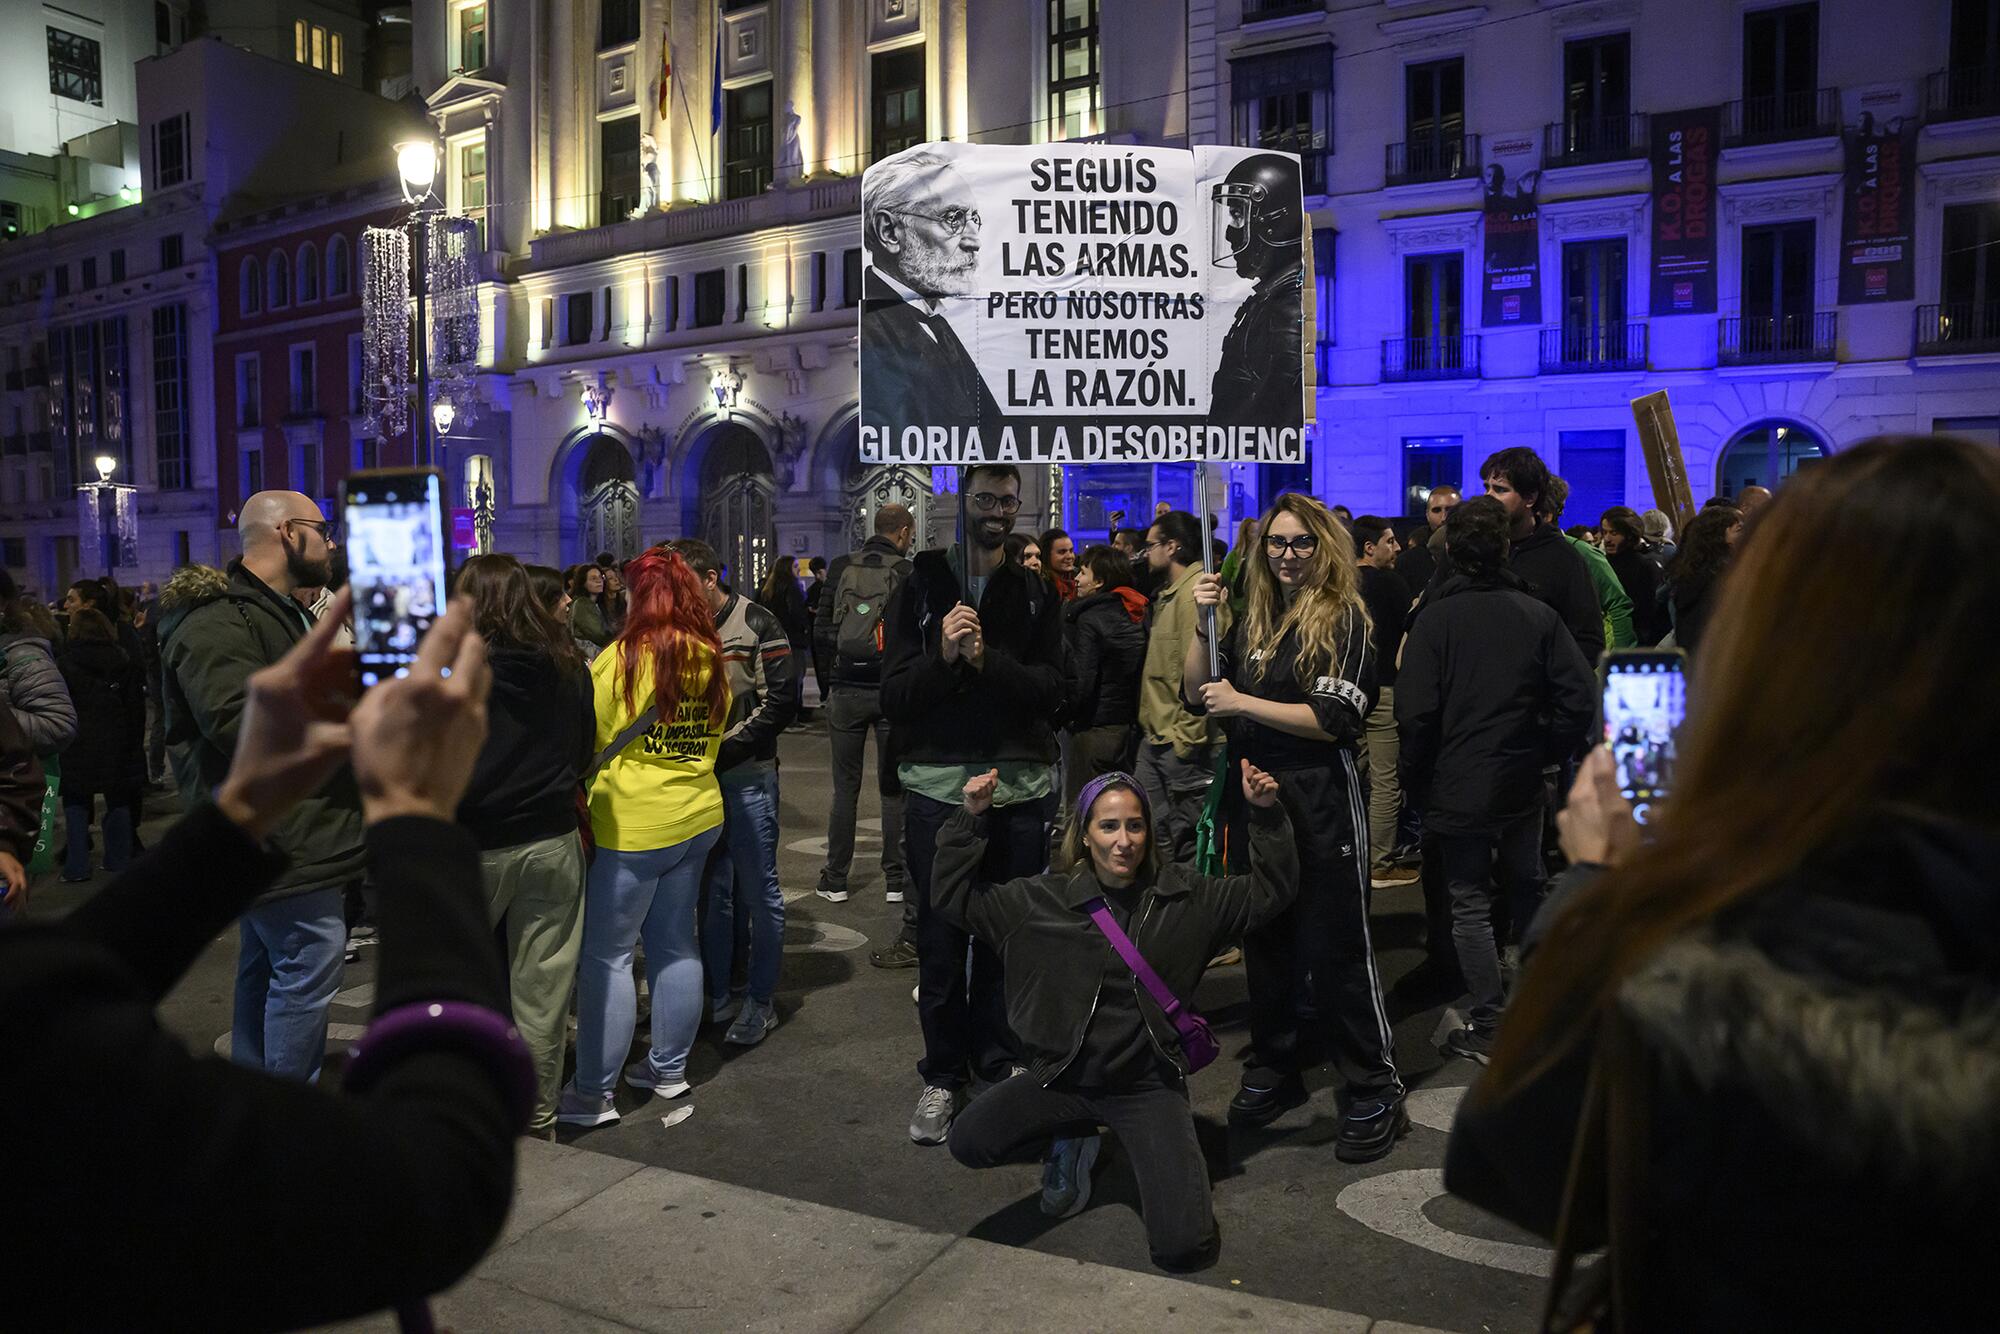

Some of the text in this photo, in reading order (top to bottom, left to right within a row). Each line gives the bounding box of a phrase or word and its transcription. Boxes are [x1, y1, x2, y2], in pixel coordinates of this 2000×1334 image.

[1669, 131, 1682, 165] LAS
[1866, 145, 1877, 173] LAS
[1031, 153, 1157, 193] SEGUÍS
[1669, 170, 1682, 183] A
[1685, 127, 1708, 238] DROGAS
[1866, 177, 1877, 187] A
[1012, 200, 1178, 236] TENIENDO
[1003, 242, 1198, 278] LAS ARMAS.
[987, 291, 1204, 320] PERO NOSOTRAS
[1026, 329, 1168, 360] TENEMOS
[1008, 362, 1196, 407] LA RAZÓN.
[860, 426, 1305, 463] GLORIA A LA DESOBEDIENCI
